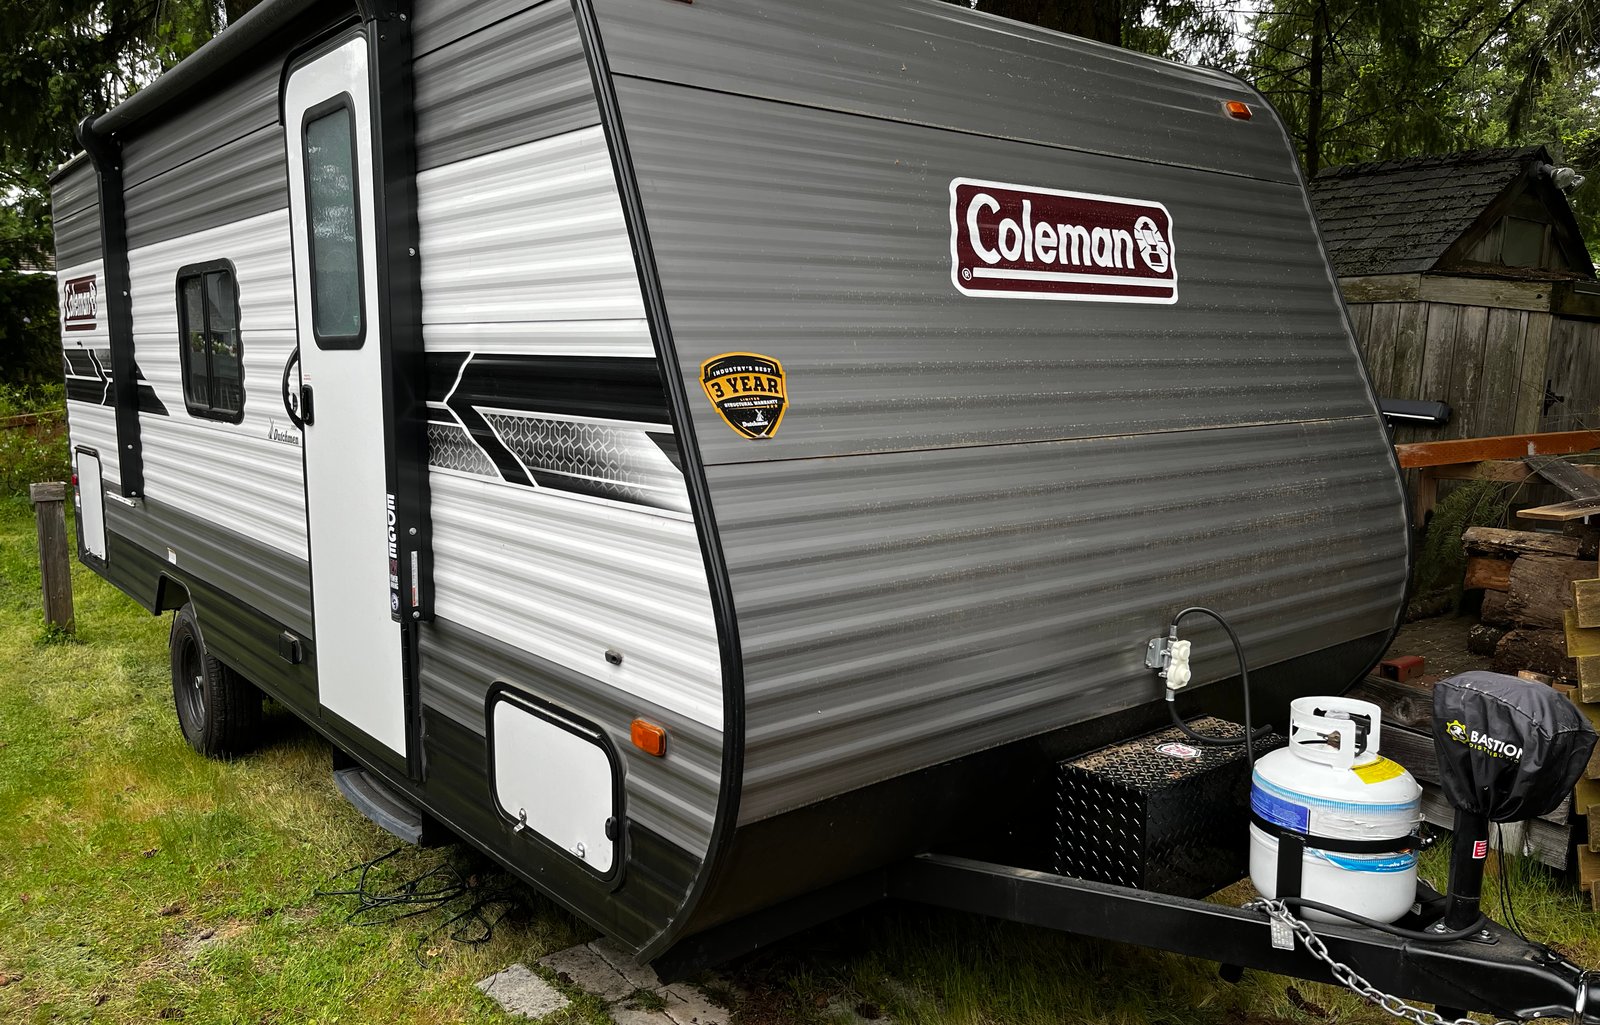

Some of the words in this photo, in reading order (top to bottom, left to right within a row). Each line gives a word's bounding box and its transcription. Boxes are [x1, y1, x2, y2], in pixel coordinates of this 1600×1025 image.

[967, 192, 1136, 270] Coleman
[65, 282, 91, 319] Coleman
[712, 365, 753, 377] INDUSTRY'S
[755, 366, 772, 374] BEST
[711, 381, 725, 399] 3
[726, 375, 780, 394] YEAR
[273, 428, 299, 445] Dutchmen
[1469, 742, 1519, 764] DISTRIBUTIO
